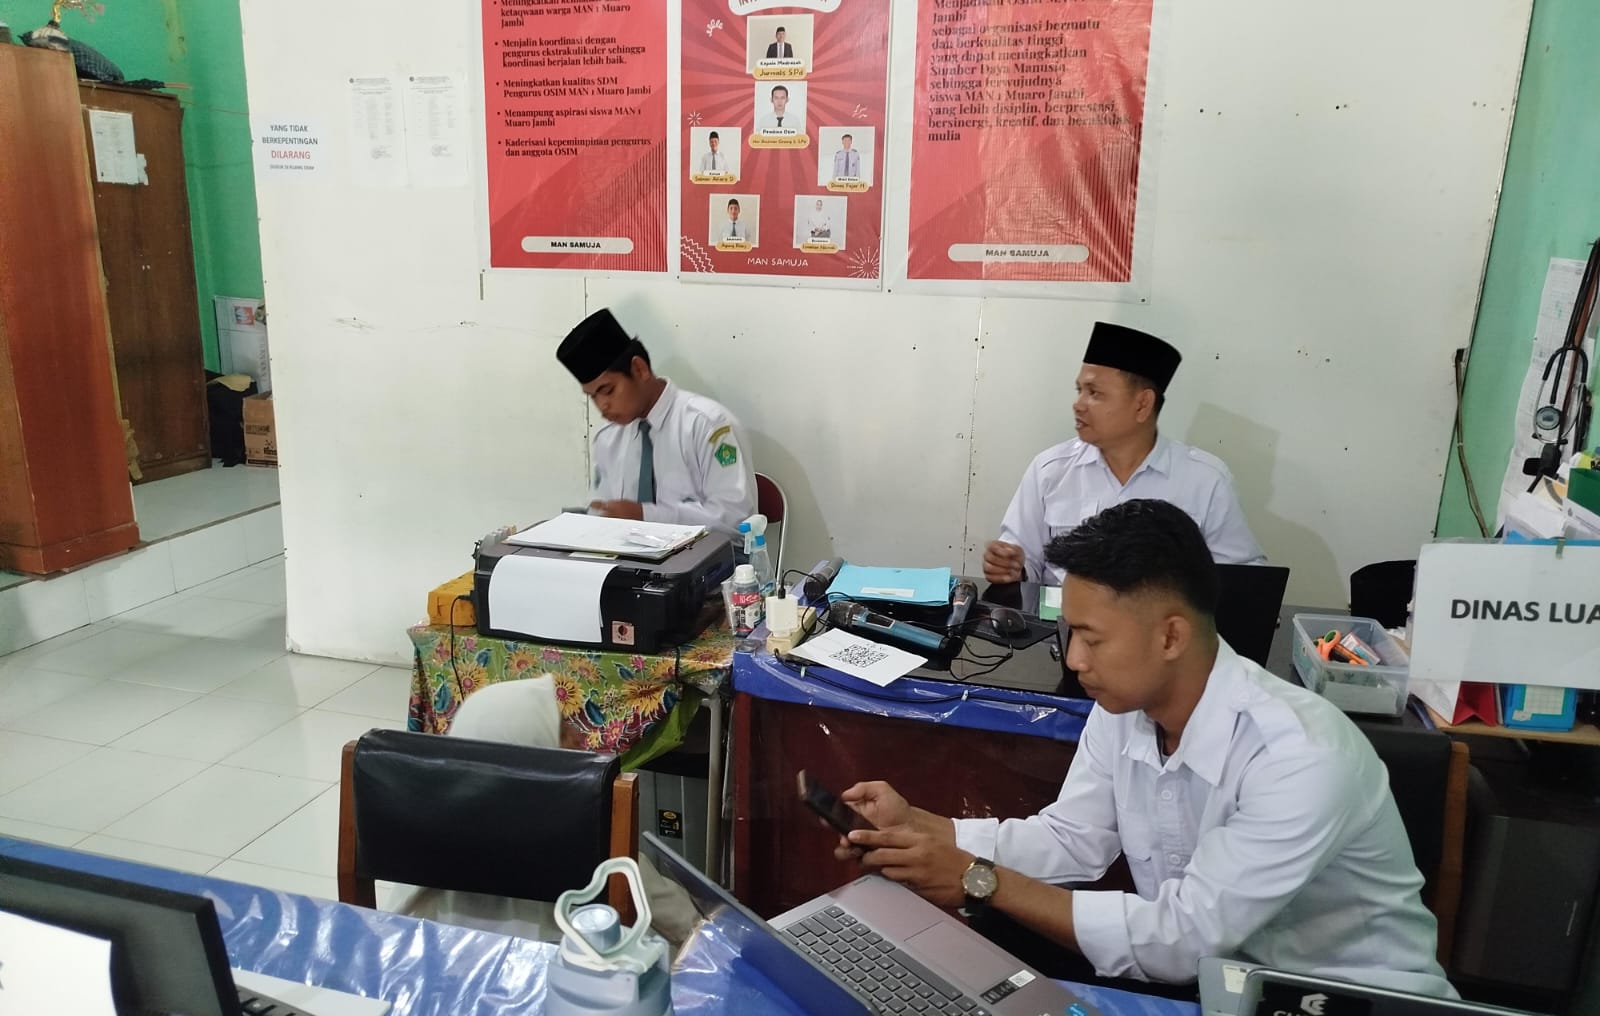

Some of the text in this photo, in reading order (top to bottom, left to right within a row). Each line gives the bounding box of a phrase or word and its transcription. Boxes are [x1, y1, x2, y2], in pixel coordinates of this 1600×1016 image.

[501, 8, 544, 17] ketaqwaan
[546, 8, 571, 16] warga
[573, 6, 594, 14] MAN
[602, 4, 631, 12] Muaro
[933, 10, 968, 24] Jambi
[501, 18, 525, 29] Jambi
[932, 23, 976, 36] sebagai
[1046, 19, 1101, 31] bermutu
[502, 35, 617, 48] Menjalin koordinasi dengan
[957, 36, 1024, 48] berkualitas
[1028, 34, 1064, 46] tinggi
[503, 48, 541, 59] pengurus
[608, 45, 646, 55] sehingga
[998, 48, 1087, 61] meningkatkan
[503, 55, 627, 68] koordinasi berjalan lebih baik.
[1014, 62, 1066, 74] Manusia
[503, 76, 618, 89] Meningkatkan kualitas SDM
[930, 77, 982, 90] sehingga
[503, 89, 542, 99] Pengurus
[543, 88, 567, 97] OSIM
[569, 88, 589, 97] MAN
[597, 87, 625, 96] Muaro
[626, 86, 651, 97] Jambi
[930, 91, 961, 102] siswa
[1006, 89, 1045, 100] Muaro
[504, 108, 554, 119] Menampung
[555, 107, 588, 118] aspirasi
[589, 106, 613, 116] siswa
[614, 106, 636, 116] MAN
[929, 106, 957, 117] yang
[960, 103, 989, 115] lebih
[505, 118, 555, 128] Muaro Jambi
[262, 136, 318, 145] BERKEPENTINGAN
[928, 130, 961, 141] mulia
[505, 138, 651, 148] Kaderisasi kepemimpinan pengurus
[271, 150, 311, 159] DILARANG
[506, 147, 578, 158] dan anggota OSIM
[985, 249, 1050, 257] MAN SAMUJA
[747, 257, 809, 267] MAN SAMUJA
[1451, 599, 1600, 624] DINAS LUA
